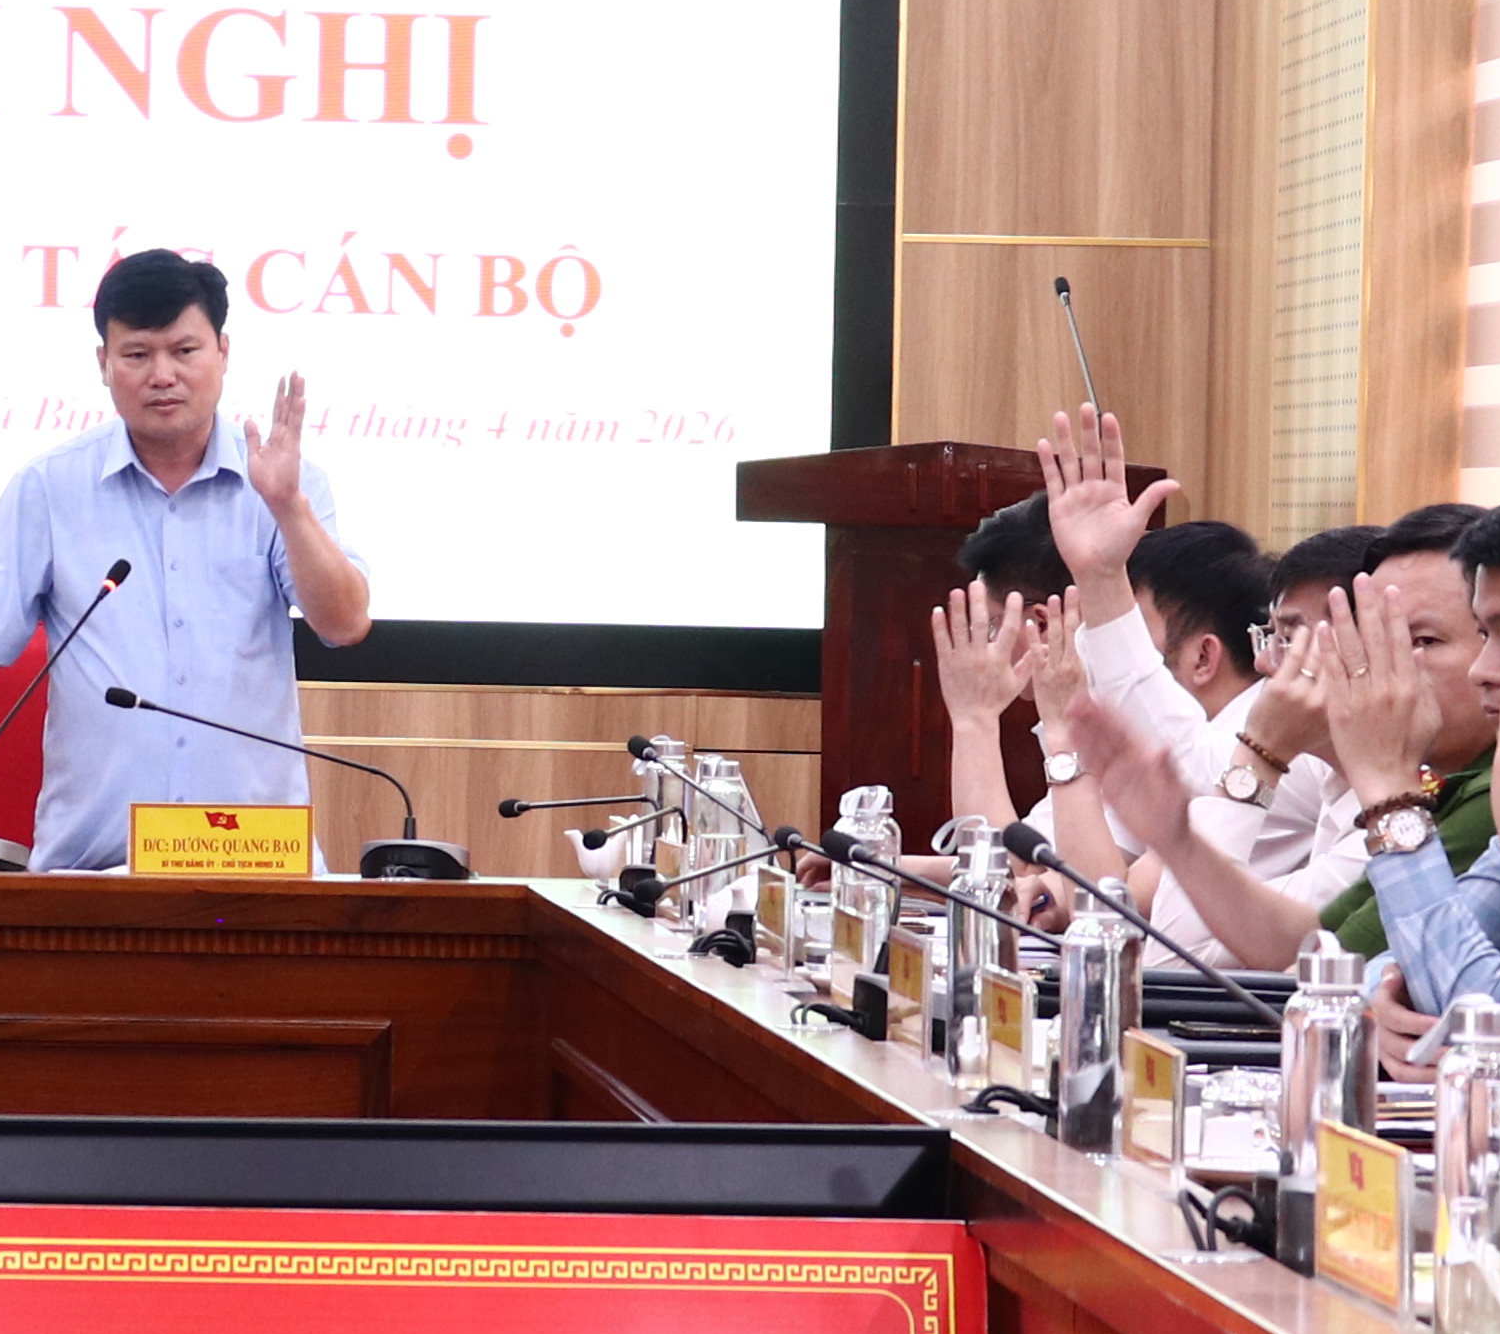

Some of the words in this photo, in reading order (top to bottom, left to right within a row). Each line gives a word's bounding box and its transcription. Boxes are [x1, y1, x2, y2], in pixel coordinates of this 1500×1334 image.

[49, 6, 492, 161] NGHỊ
[245, 231, 445, 316] CÁN
[472, 244, 603, 339] BỘ
[347, 402, 468, 447] tháng
[486, 408, 508, 441] 4
[526, 409, 620, 443] năm
[636, 409, 736, 445] 2026
[143, 838, 169, 853] Đ/C:
[172, 836, 219, 853] DƯƠNG
[222, 838, 269, 855] QUANG
[273, 839, 300, 857] BẠO
